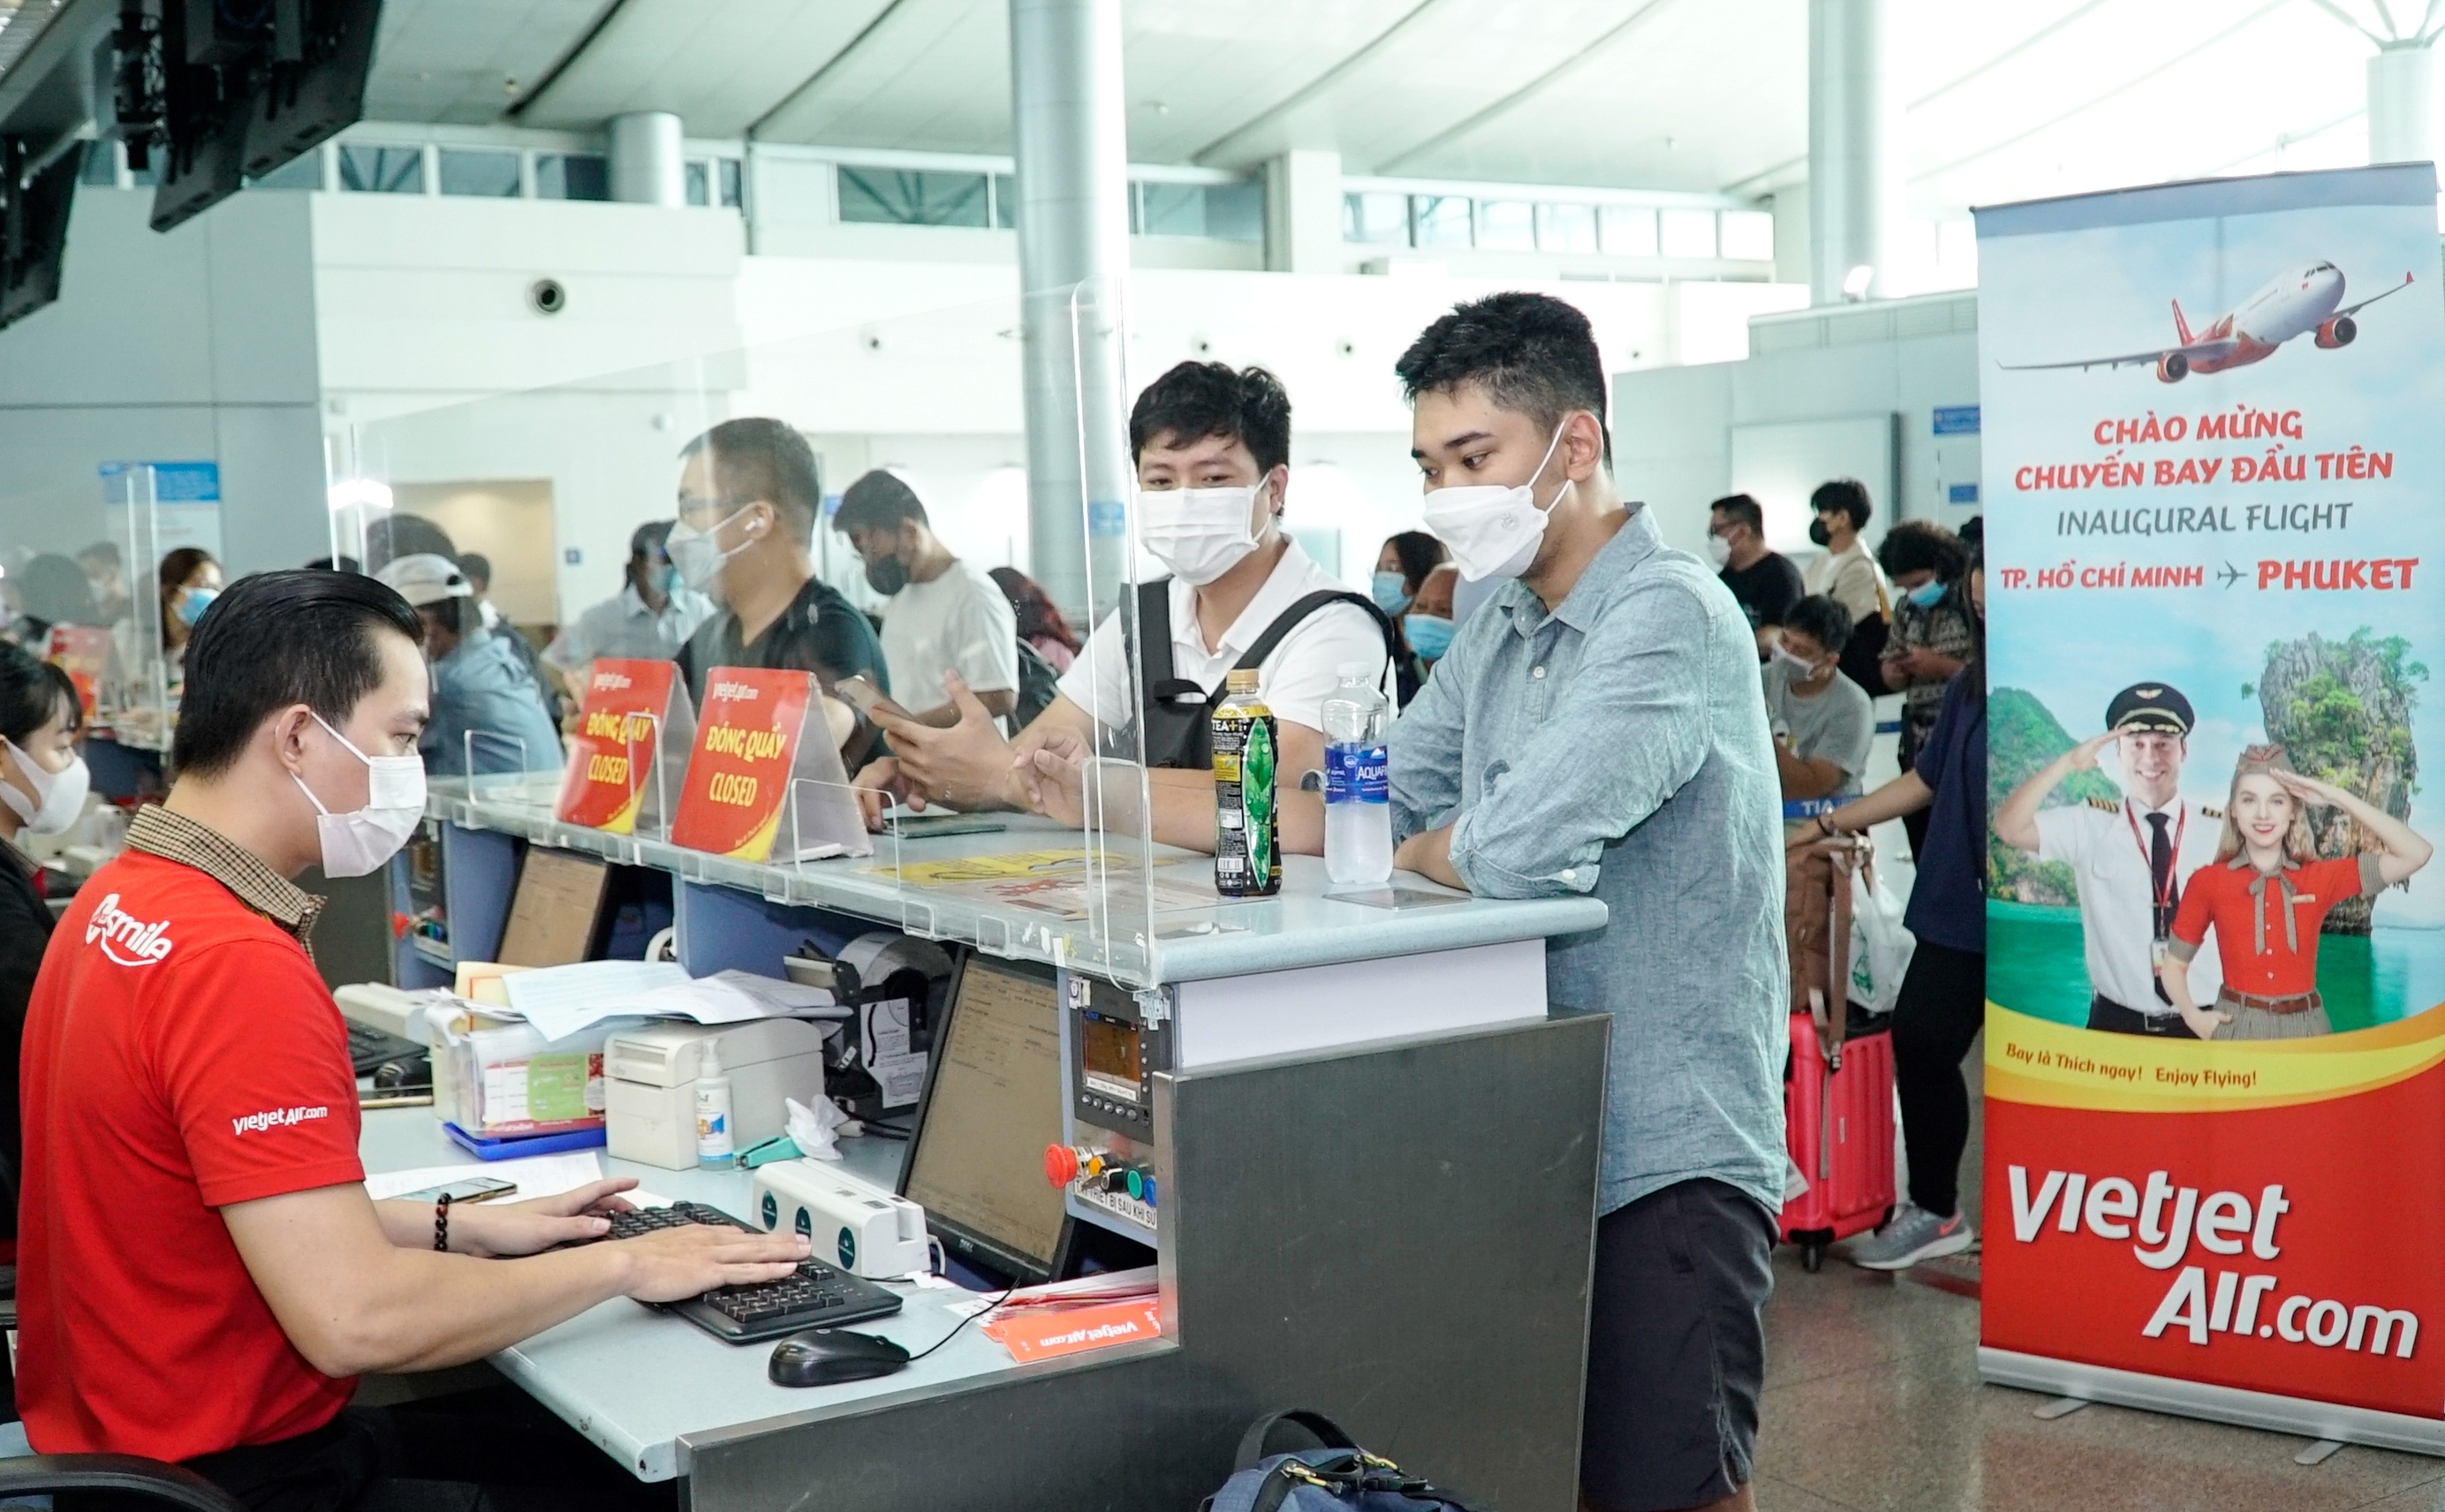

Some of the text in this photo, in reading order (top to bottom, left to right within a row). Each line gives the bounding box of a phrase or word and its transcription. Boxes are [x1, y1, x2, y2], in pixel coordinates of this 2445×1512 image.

[2094, 404, 2304, 446] CHÀO MỪNG
[2015, 443, 2394, 491] CHUYẾN BAY ĐẦU TIÊN
[2057, 502, 2353, 537] INAUGURAL FLIGHT
[2001, 557, 2419, 591] TP. HỒ CHÍ MINH PHUKET
[705, 721, 747, 759] ĐÓNG
[587, 753, 629, 785] CLOSED
[709, 772, 758, 807] CLOSED
[2006, 1042, 2258, 1088] Bay là Thích ngay! Enjoy Flying!
[2008, 1164, 2290, 1270] Vietjet
[2142, 1265, 2419, 1360] Air.com
